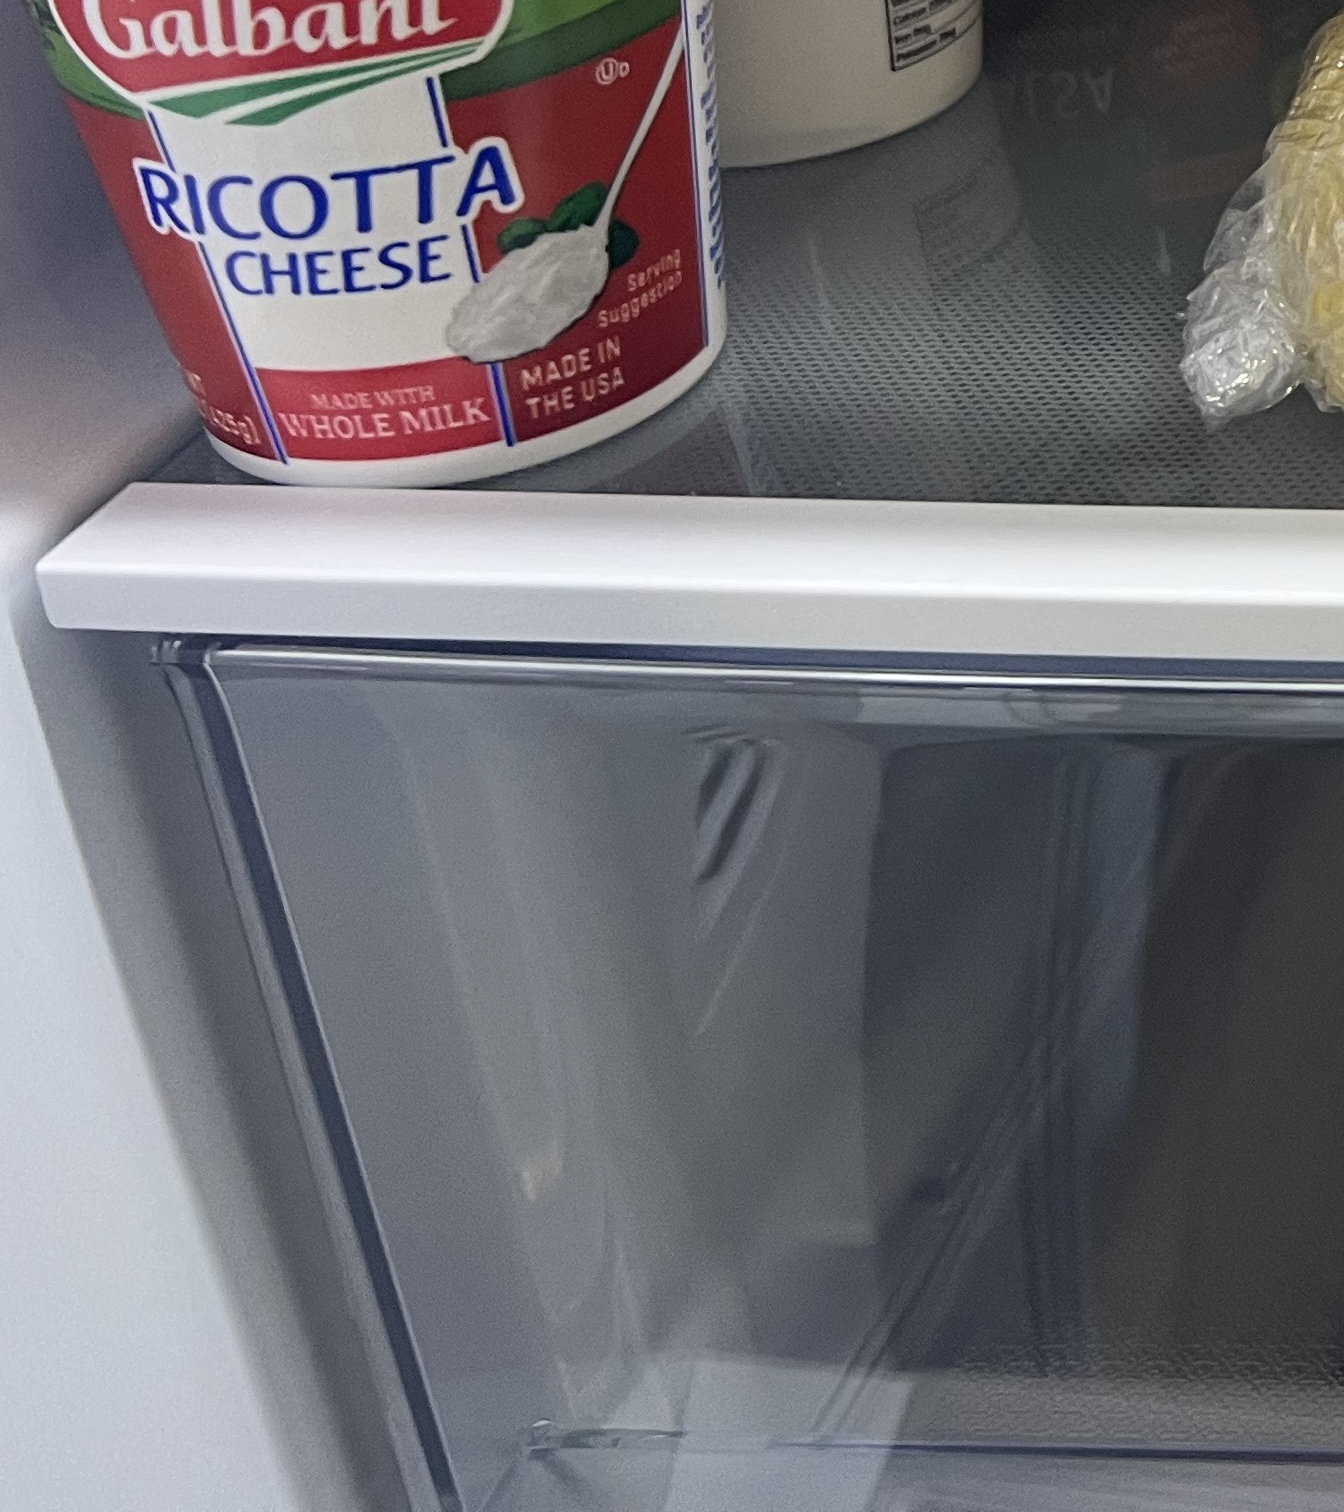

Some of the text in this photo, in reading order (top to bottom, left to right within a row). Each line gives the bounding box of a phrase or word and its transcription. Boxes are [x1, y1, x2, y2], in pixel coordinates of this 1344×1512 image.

[139, 144, 518, 241] RICOTTA
[226, 234, 452, 296] CHEESE
[627, 248, 682, 292] Serving
[598, 271, 683, 328] Suggestion
[520, 335, 621, 392] MADE IN
[278, 397, 492, 440] WHOLE MILK
[311, 392, 374, 411] MADE
[525, 366, 625, 419] THE USA
